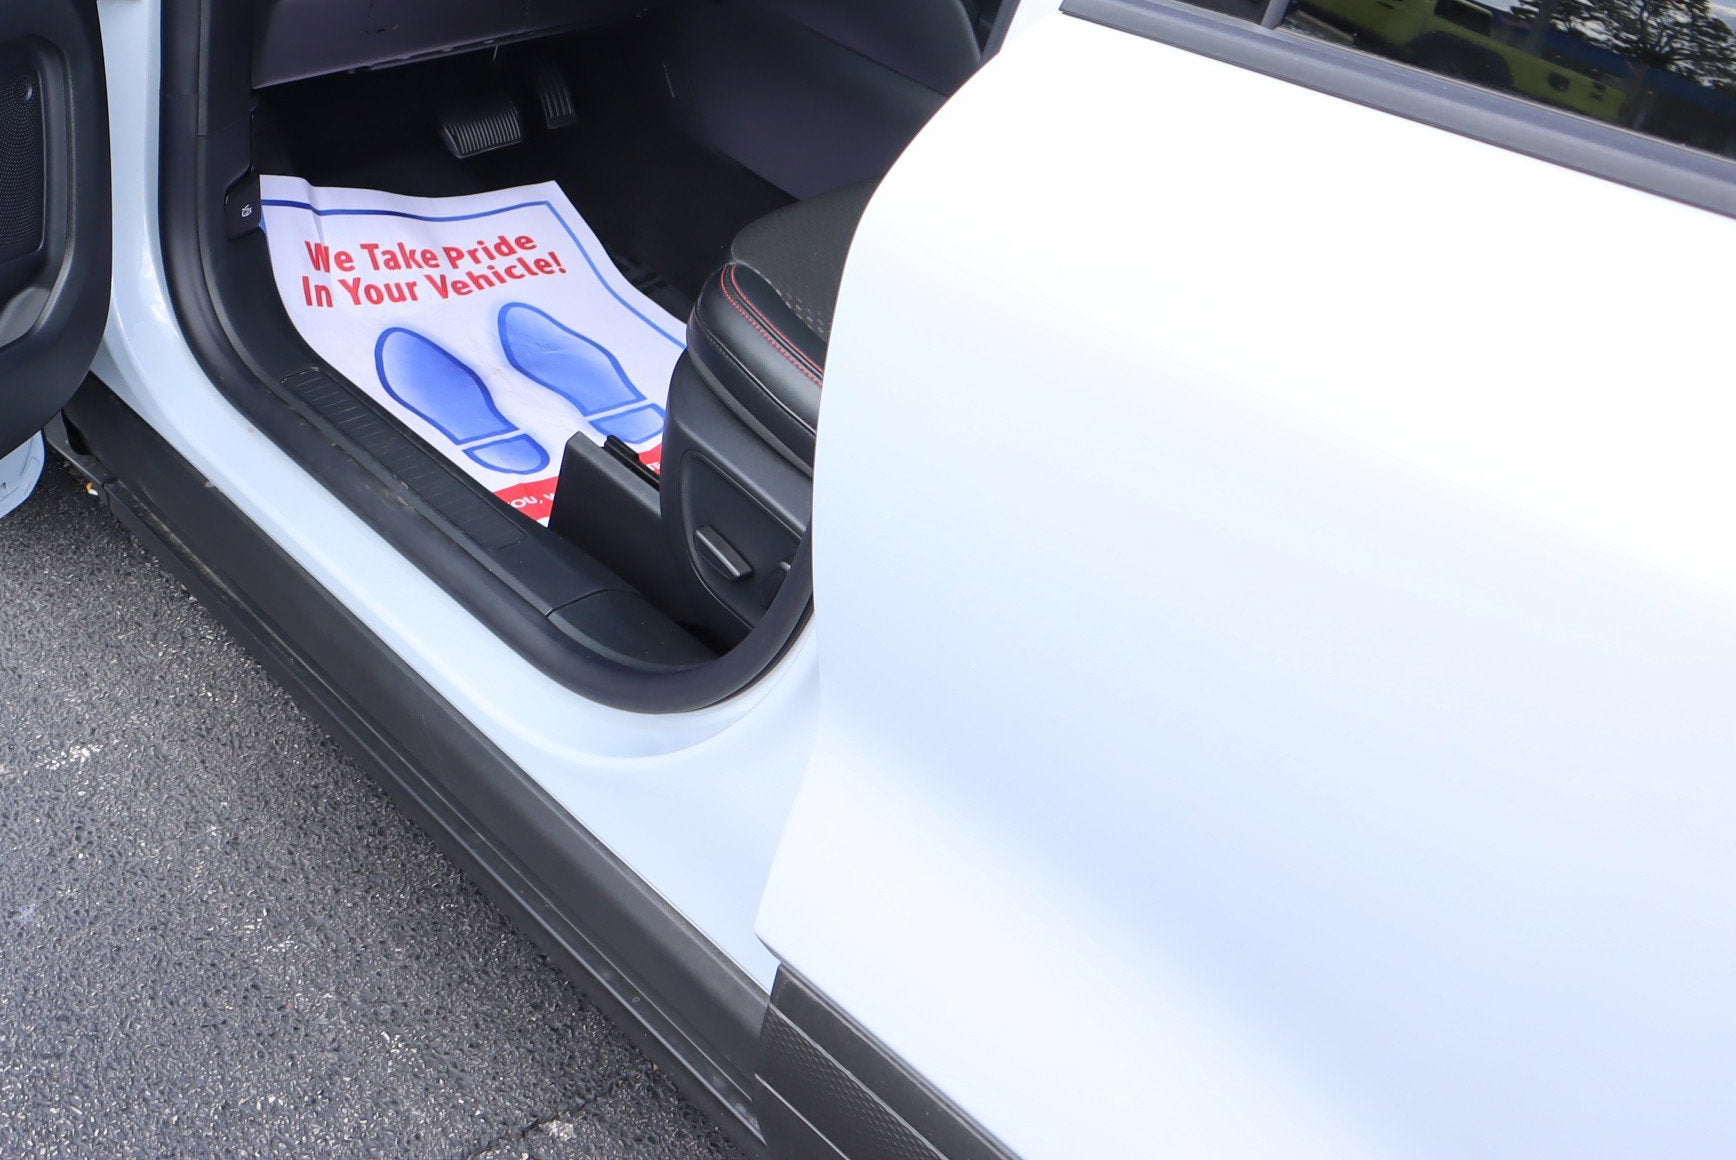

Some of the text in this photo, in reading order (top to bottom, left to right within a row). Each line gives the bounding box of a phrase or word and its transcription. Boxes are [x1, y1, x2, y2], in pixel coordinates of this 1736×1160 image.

[305, 234, 537, 274] We Take Pride
[302, 251, 567, 308] In Your Vehicle!
[508, 494, 544, 509] OU,
